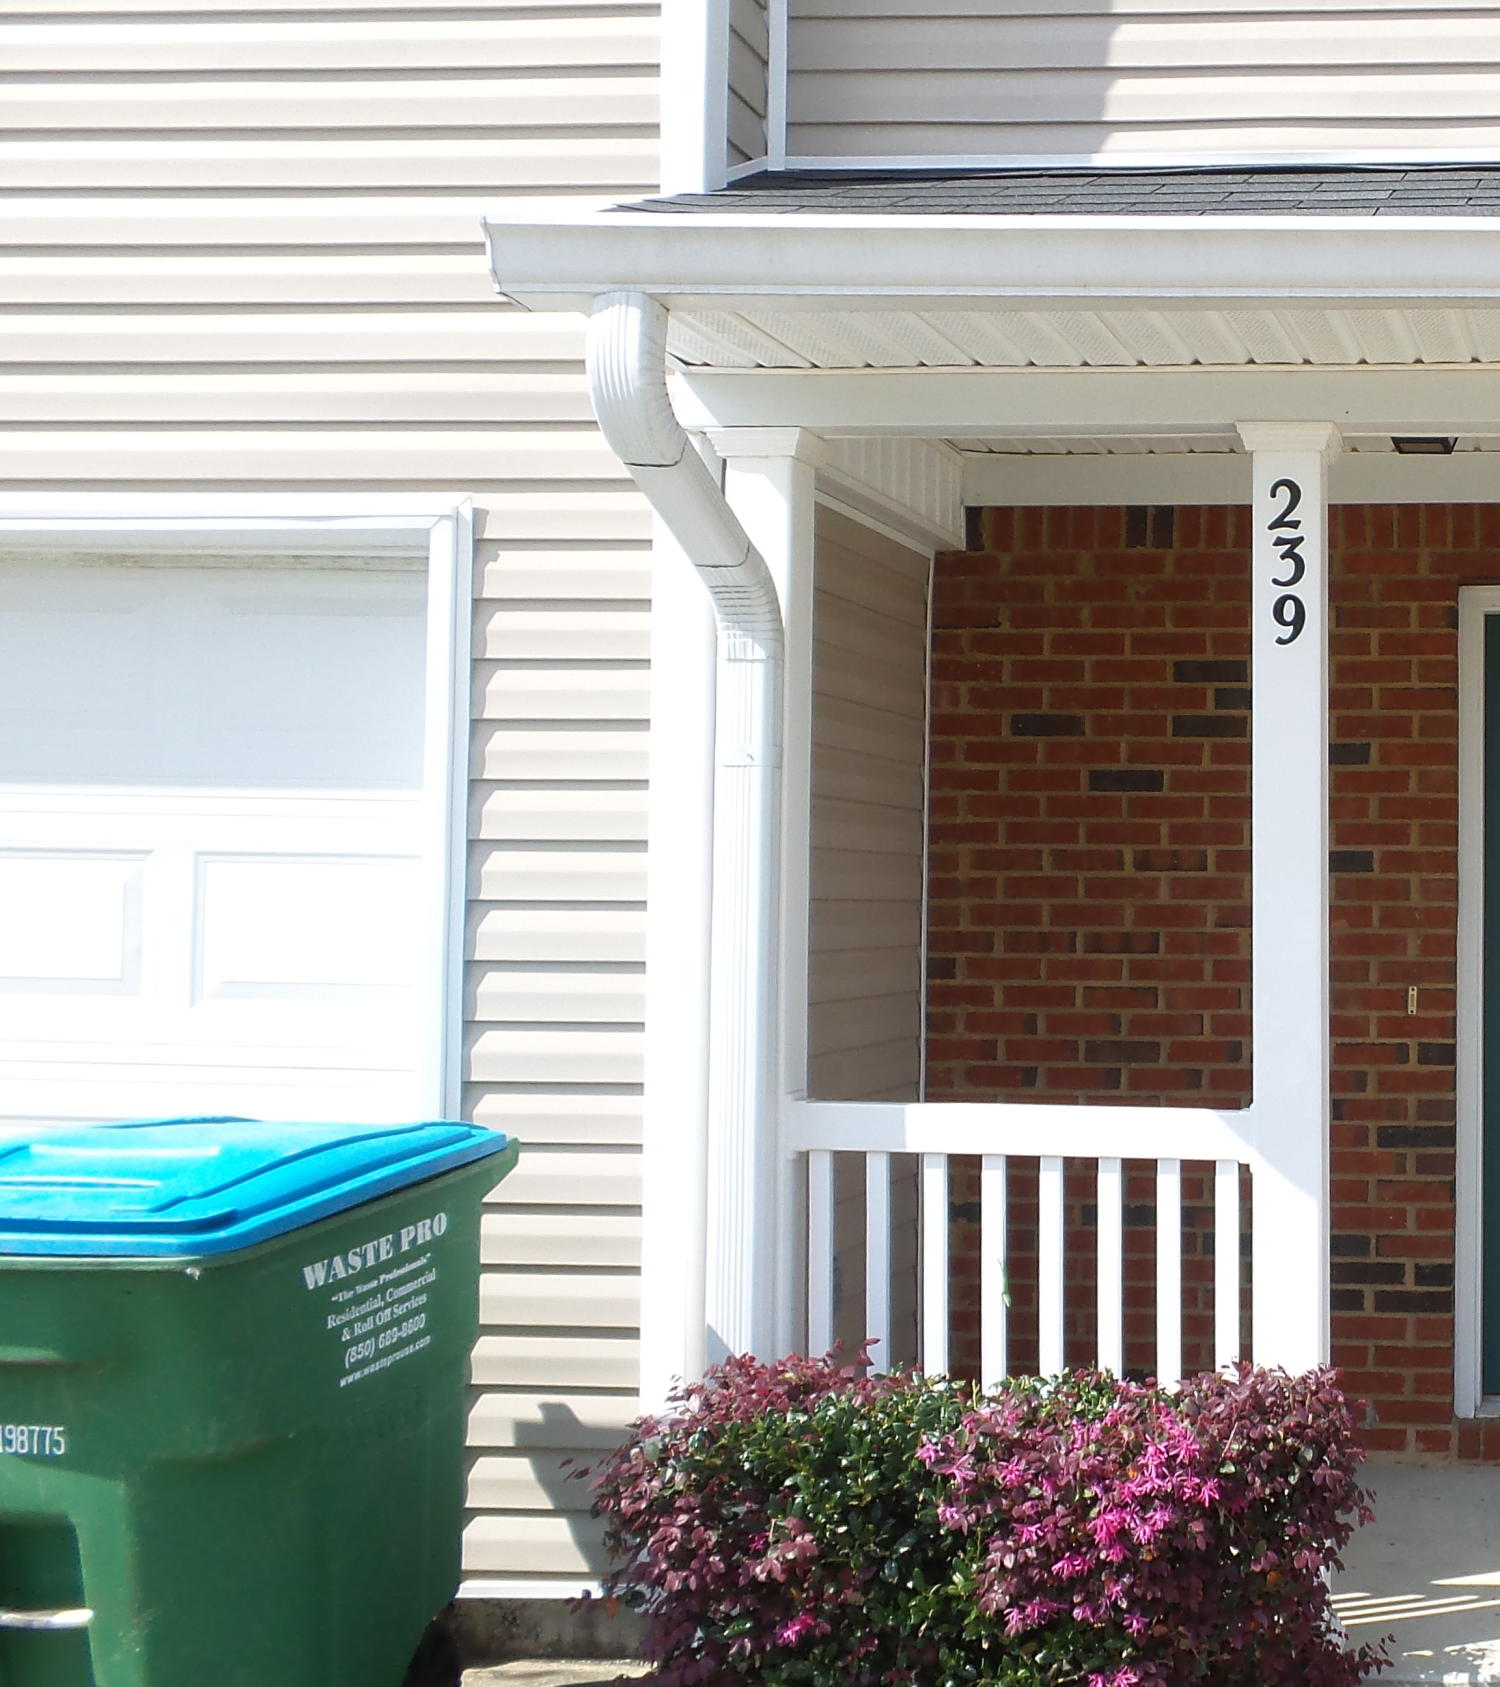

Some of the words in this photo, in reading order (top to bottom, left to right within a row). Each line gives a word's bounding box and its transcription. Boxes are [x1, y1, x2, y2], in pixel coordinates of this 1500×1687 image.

[1267, 478, 1306, 646] 239
[303, 1234, 394, 1291] WASTE
[400, 1212, 448, 1253] PRO
[326, 1294, 385, 1329] Residential,
[386, 1267, 436, 1302] Commercial
[341, 1327, 351, 1342] &
[354, 1315, 374, 1337] Roll
[375, 1306, 393, 1326] Off
[393, 1293, 428, 1319] Services
[345, 1337, 376, 1369] (850)
[379, 1312, 426, 1349] 689-8600
